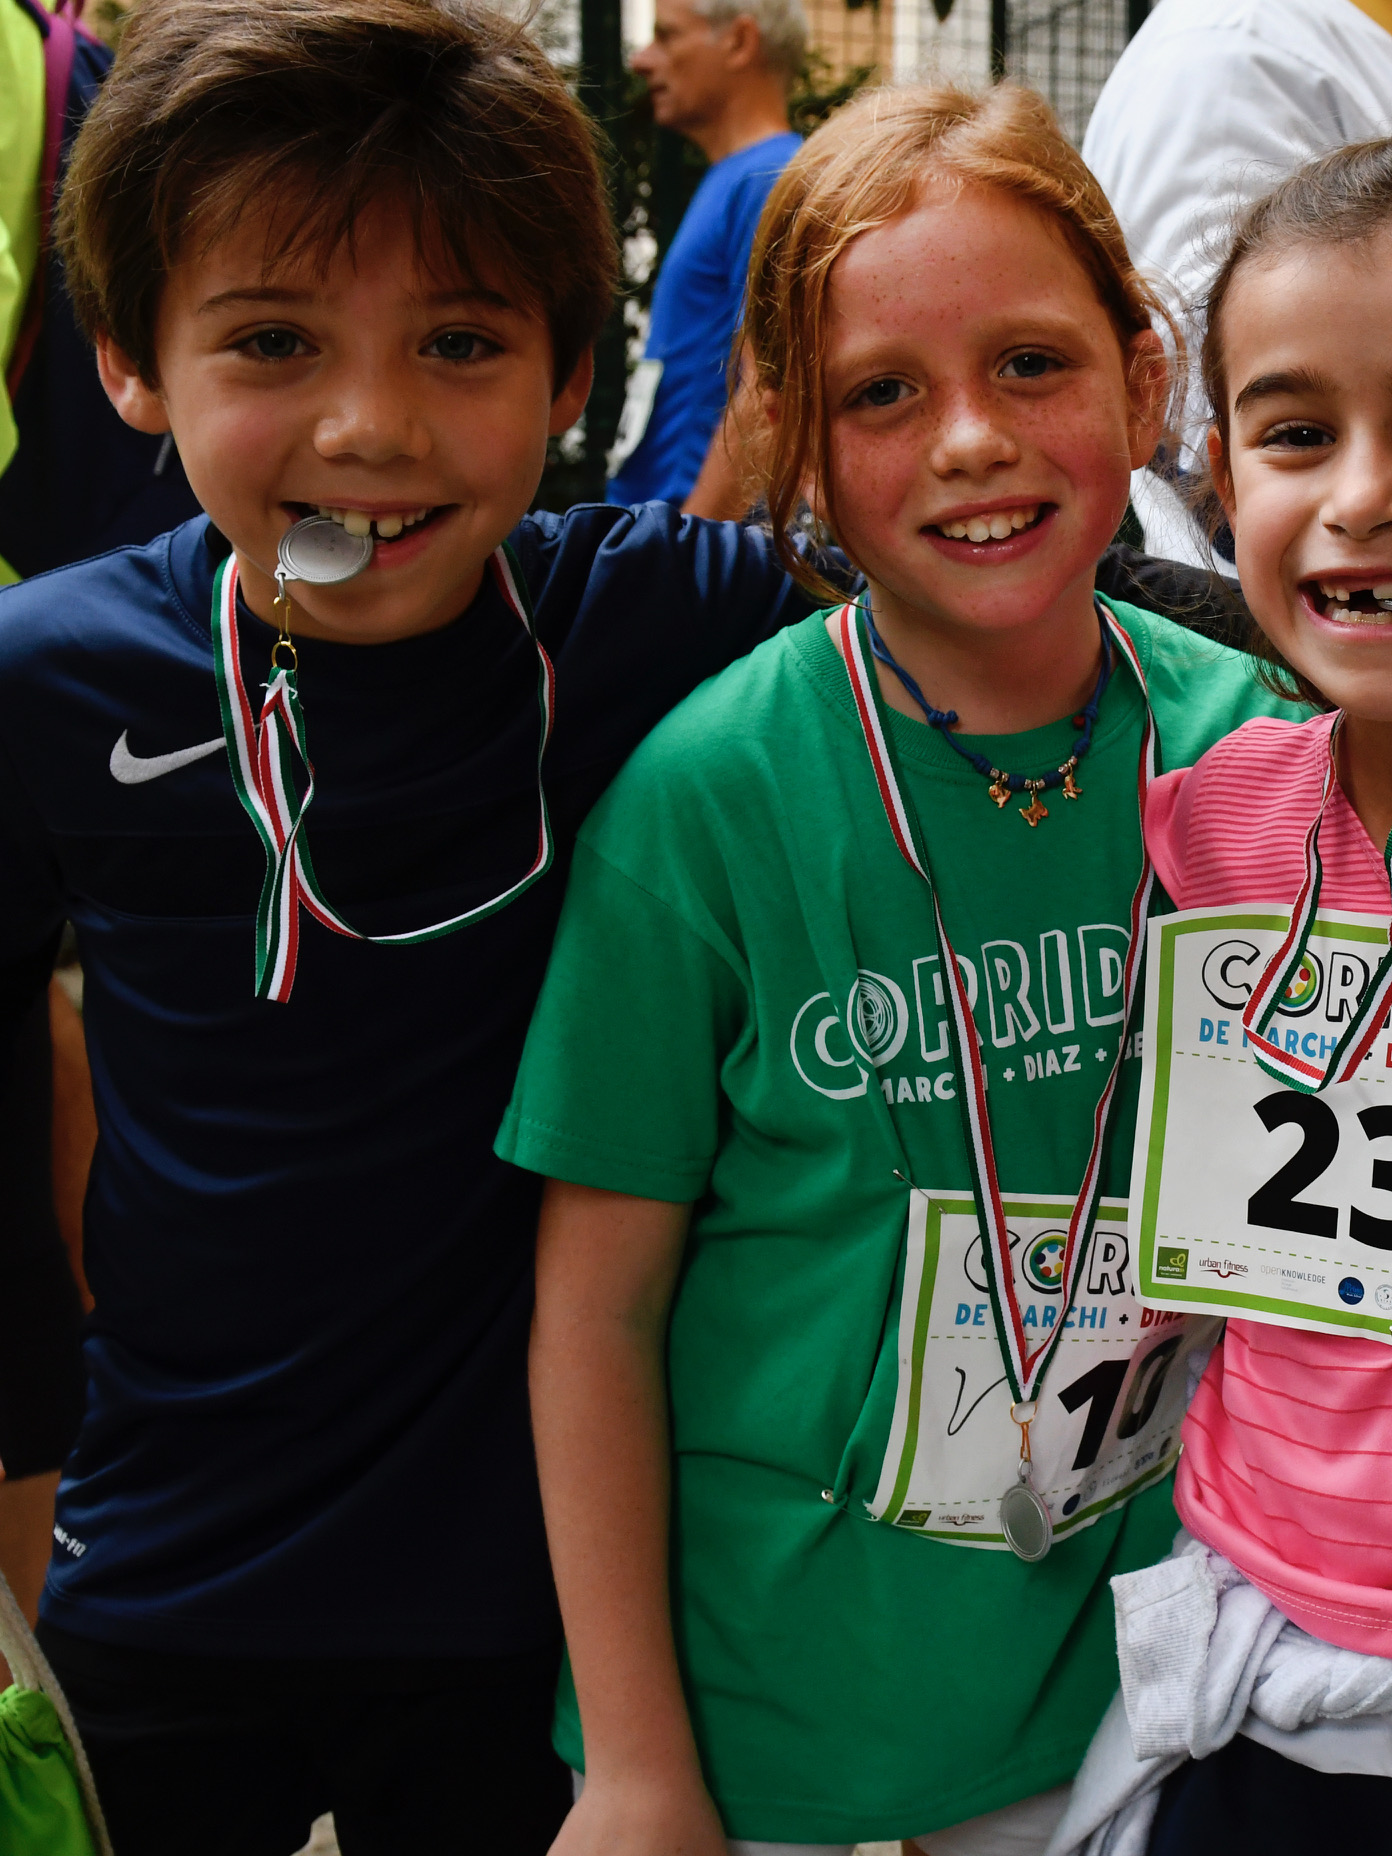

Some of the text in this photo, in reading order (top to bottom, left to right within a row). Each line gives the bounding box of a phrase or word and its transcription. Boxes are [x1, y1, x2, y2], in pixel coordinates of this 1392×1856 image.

[1200, 1017, 1230, 1045] DE
[1024, 1044, 1081, 1082] DIAZ
[1199, 1258, 1249, 1273] urban fitness
[955, 1303, 988, 1326] DE
